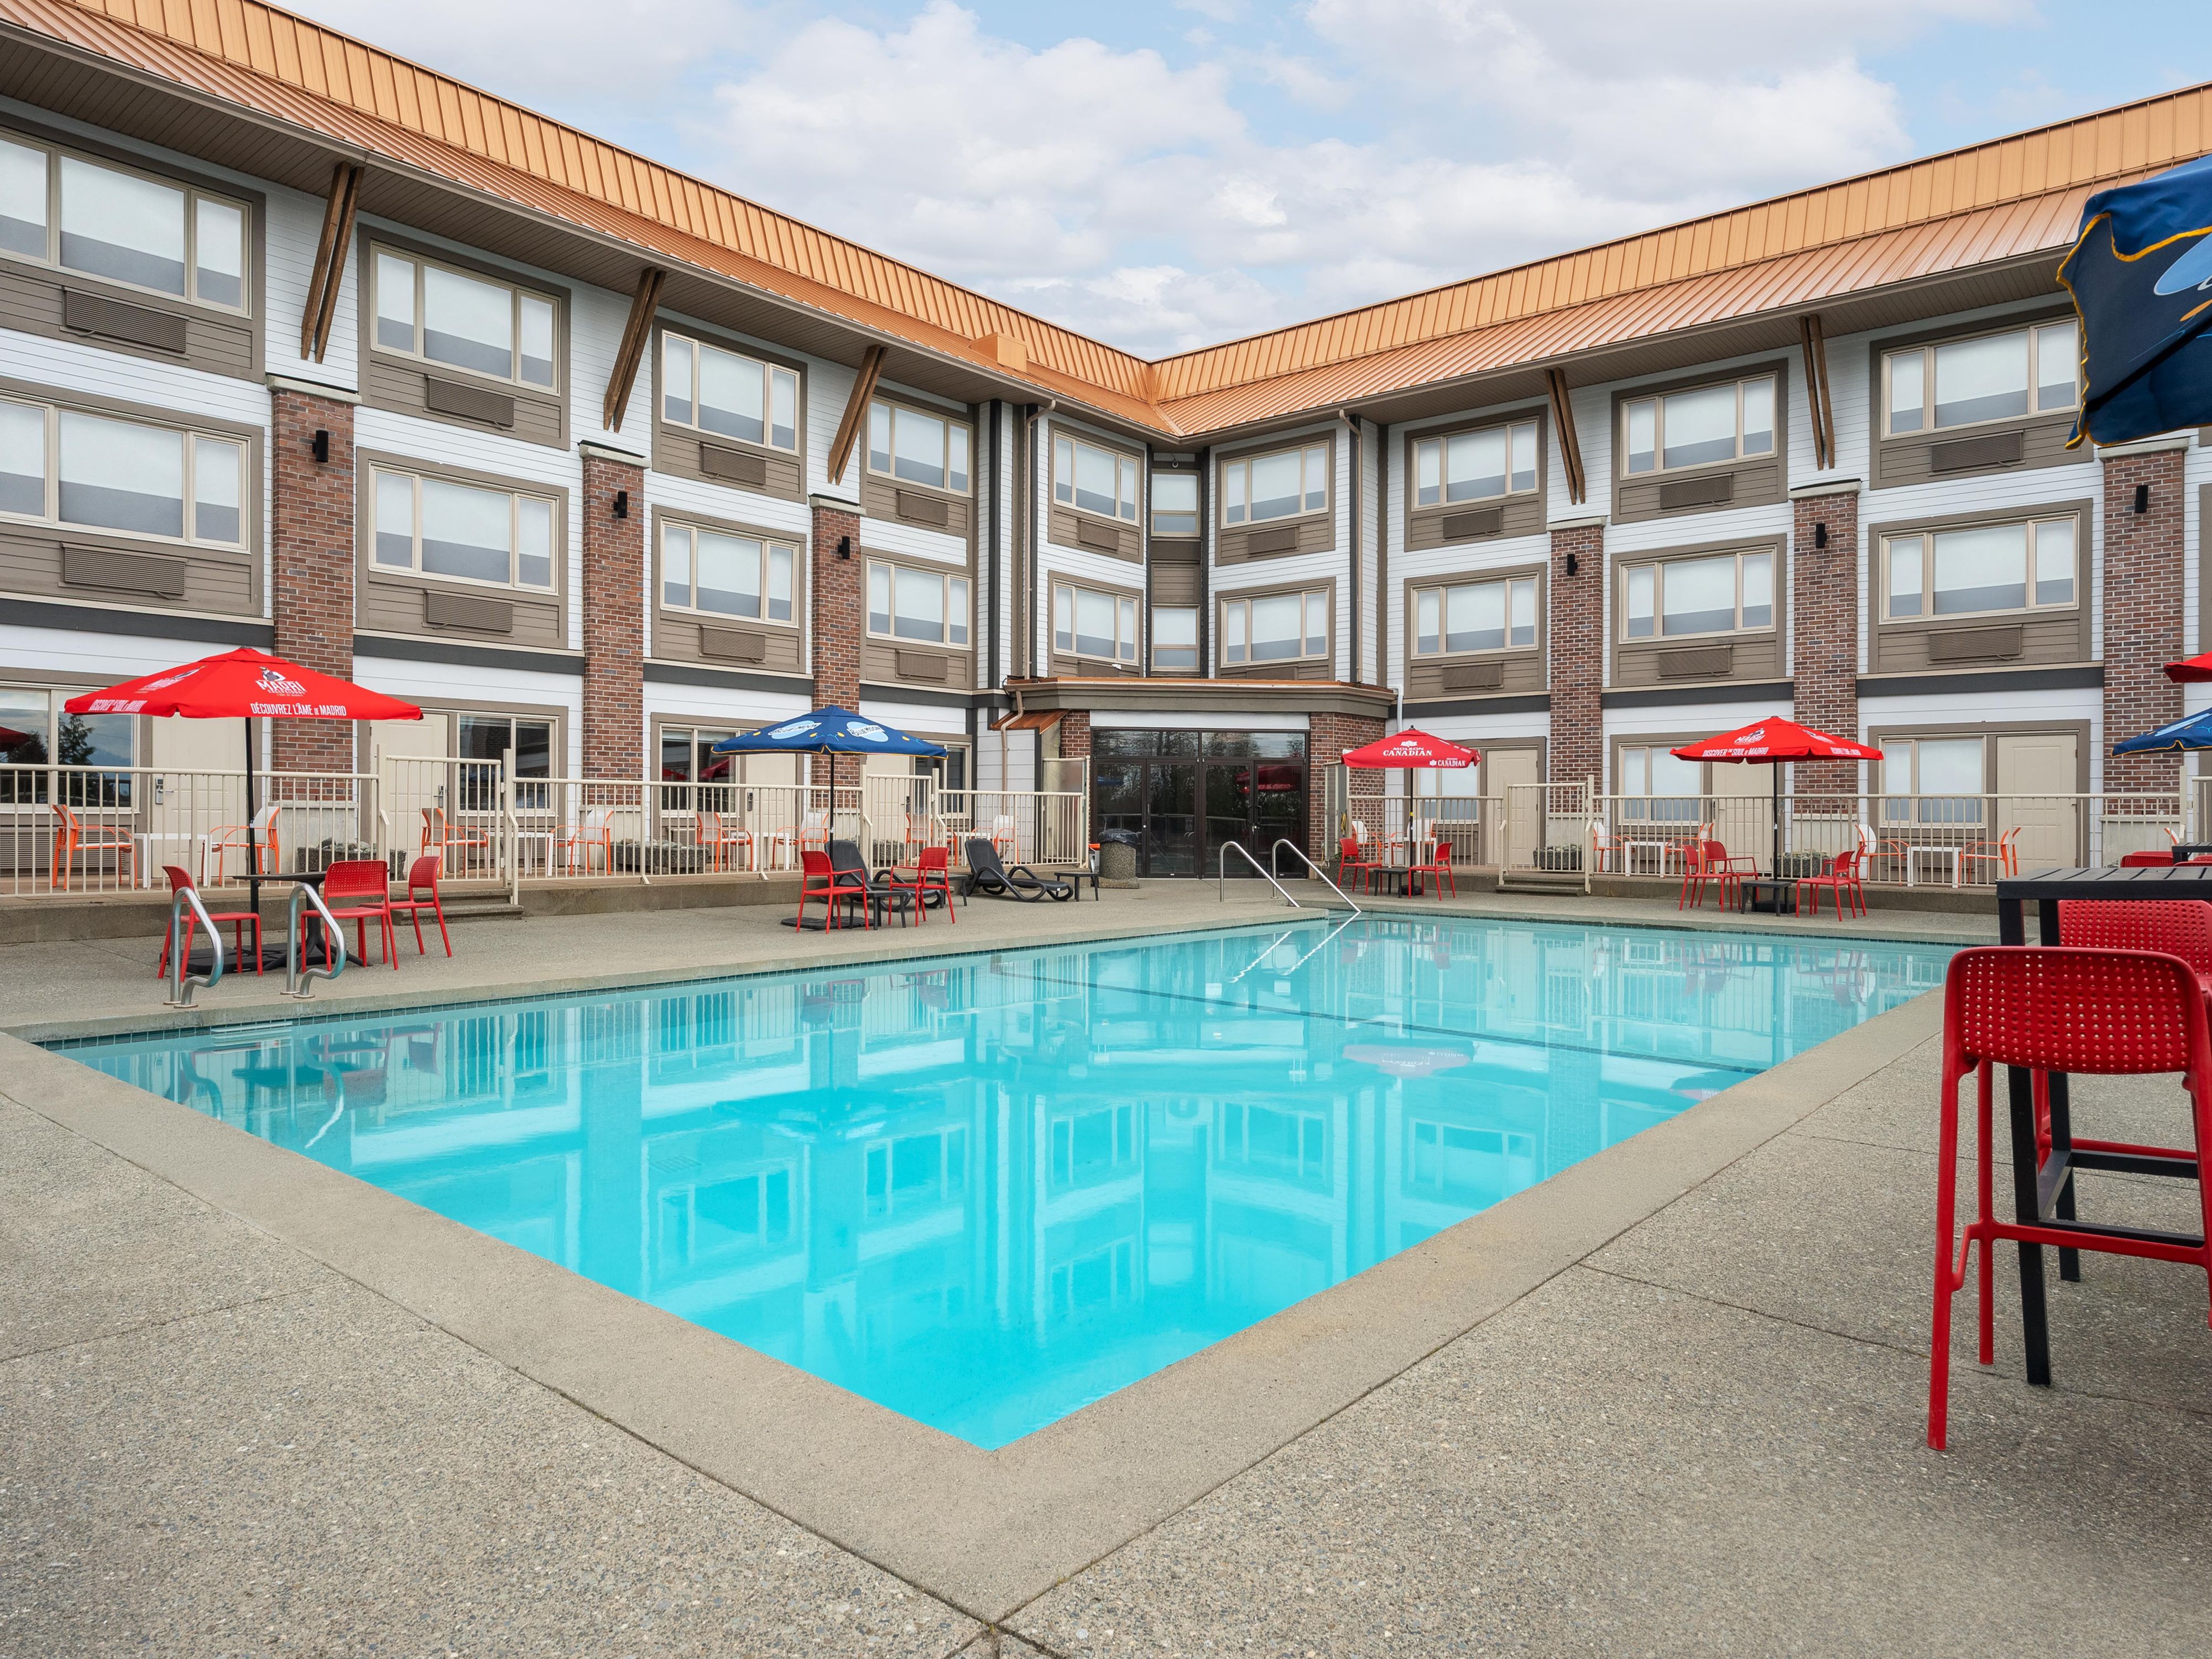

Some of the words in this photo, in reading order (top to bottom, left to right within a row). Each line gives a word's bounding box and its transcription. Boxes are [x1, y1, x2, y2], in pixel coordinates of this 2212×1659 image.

[250, 702, 293, 714] DÉCOUVREZ
[319, 705, 347, 716] MADRID
[1702, 749, 1728, 757] DISCOVER
[1747, 747, 1769, 755] MADRID
